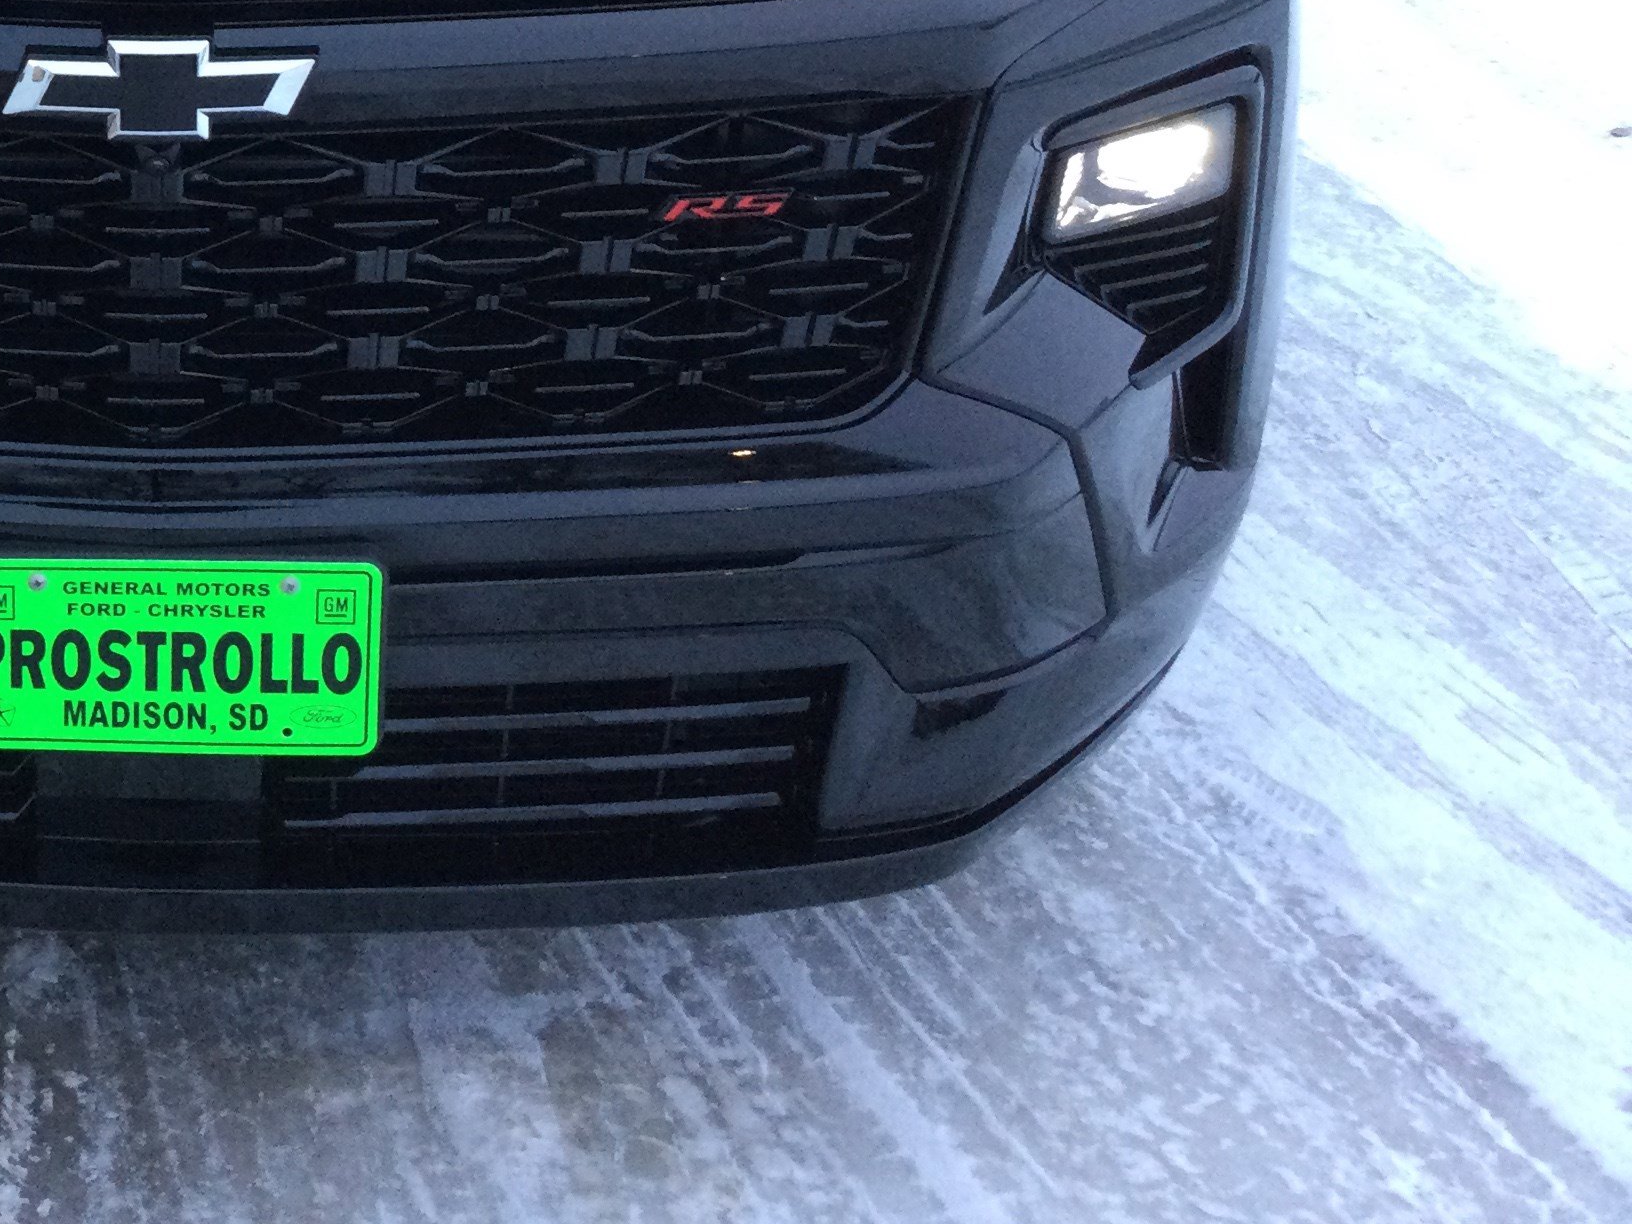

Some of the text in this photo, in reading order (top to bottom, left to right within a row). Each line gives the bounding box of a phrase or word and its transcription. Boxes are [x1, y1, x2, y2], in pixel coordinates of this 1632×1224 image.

[664, 192, 789, 222] RS
[62, 581, 271, 597] GENERAL MOTORS
[67, 602, 126, 617] FORD
[148, 603, 266, 619] CHRYSLER
[324, 596, 349, 613] GM
[62, 699, 269, 735] MADISON, SD
[302, 708, 344, 724] Ford
